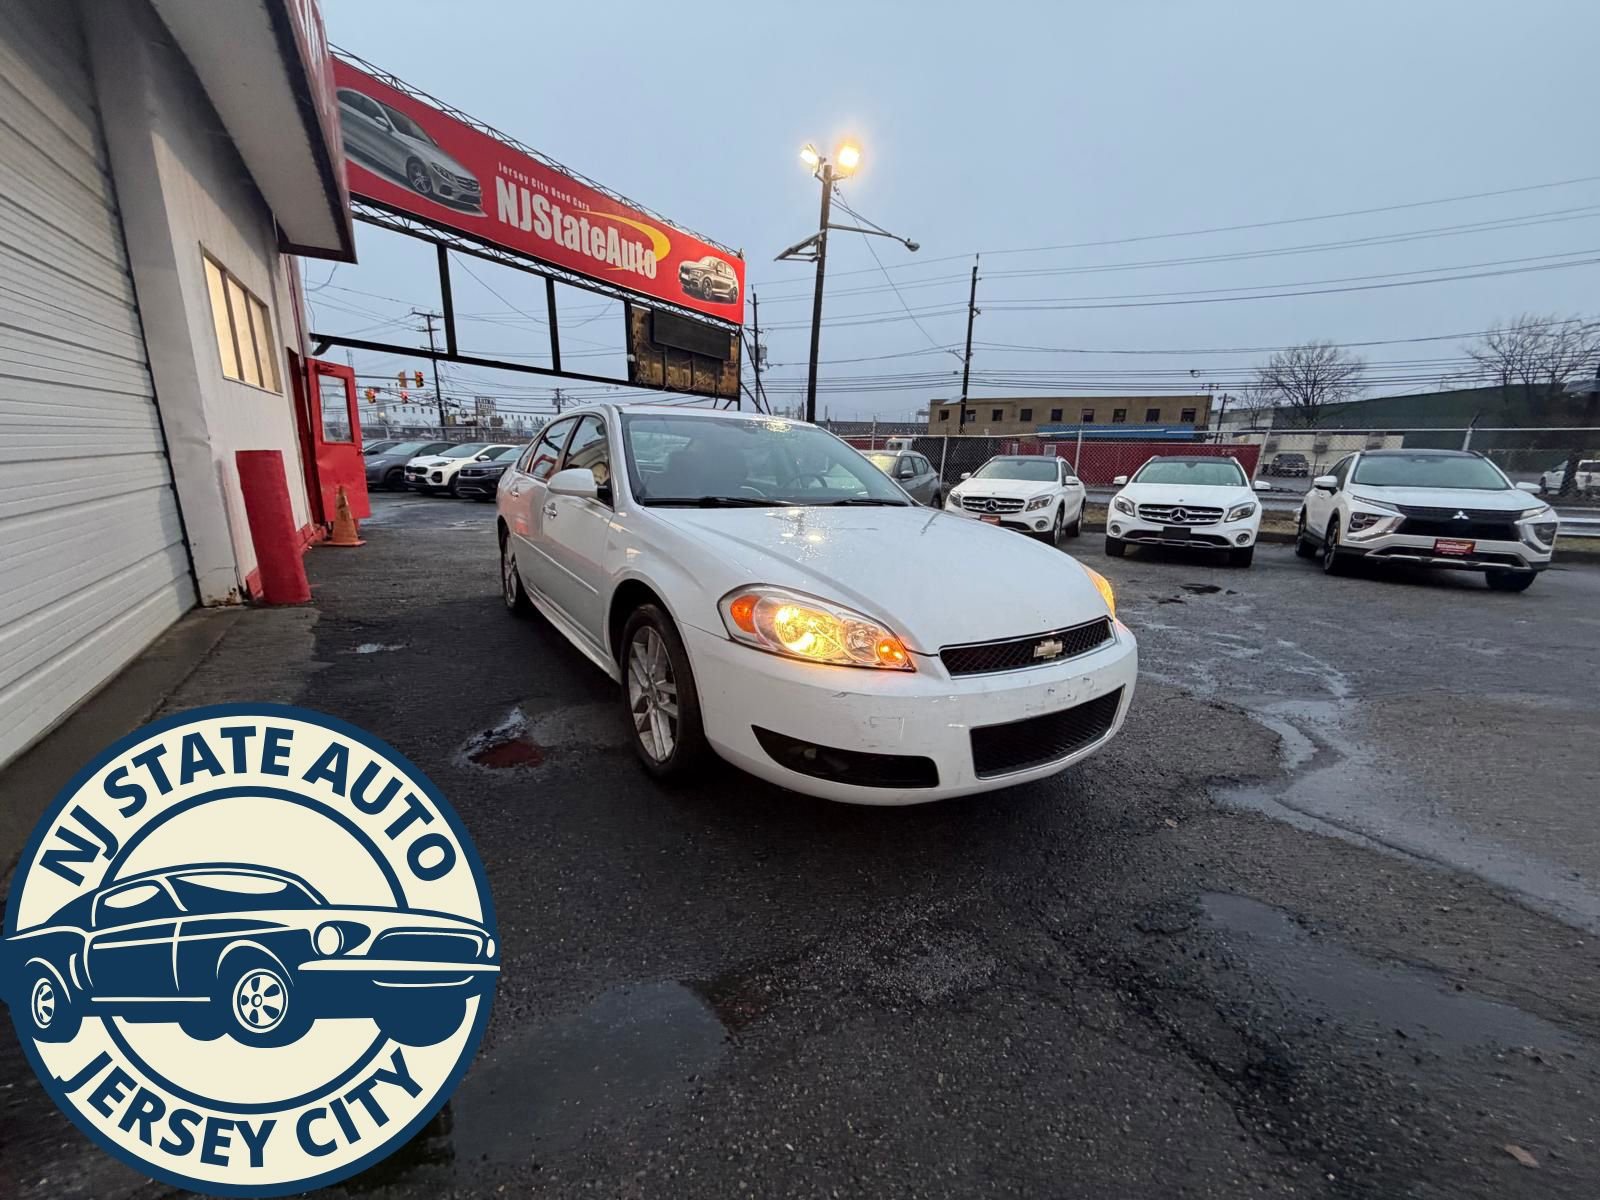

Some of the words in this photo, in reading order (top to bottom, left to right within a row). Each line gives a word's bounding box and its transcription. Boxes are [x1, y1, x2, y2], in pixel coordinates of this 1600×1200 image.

[531, 178, 549, 194] City
[551, 187, 571, 204] Used
[495, 175, 657, 280] NJStateAuto
